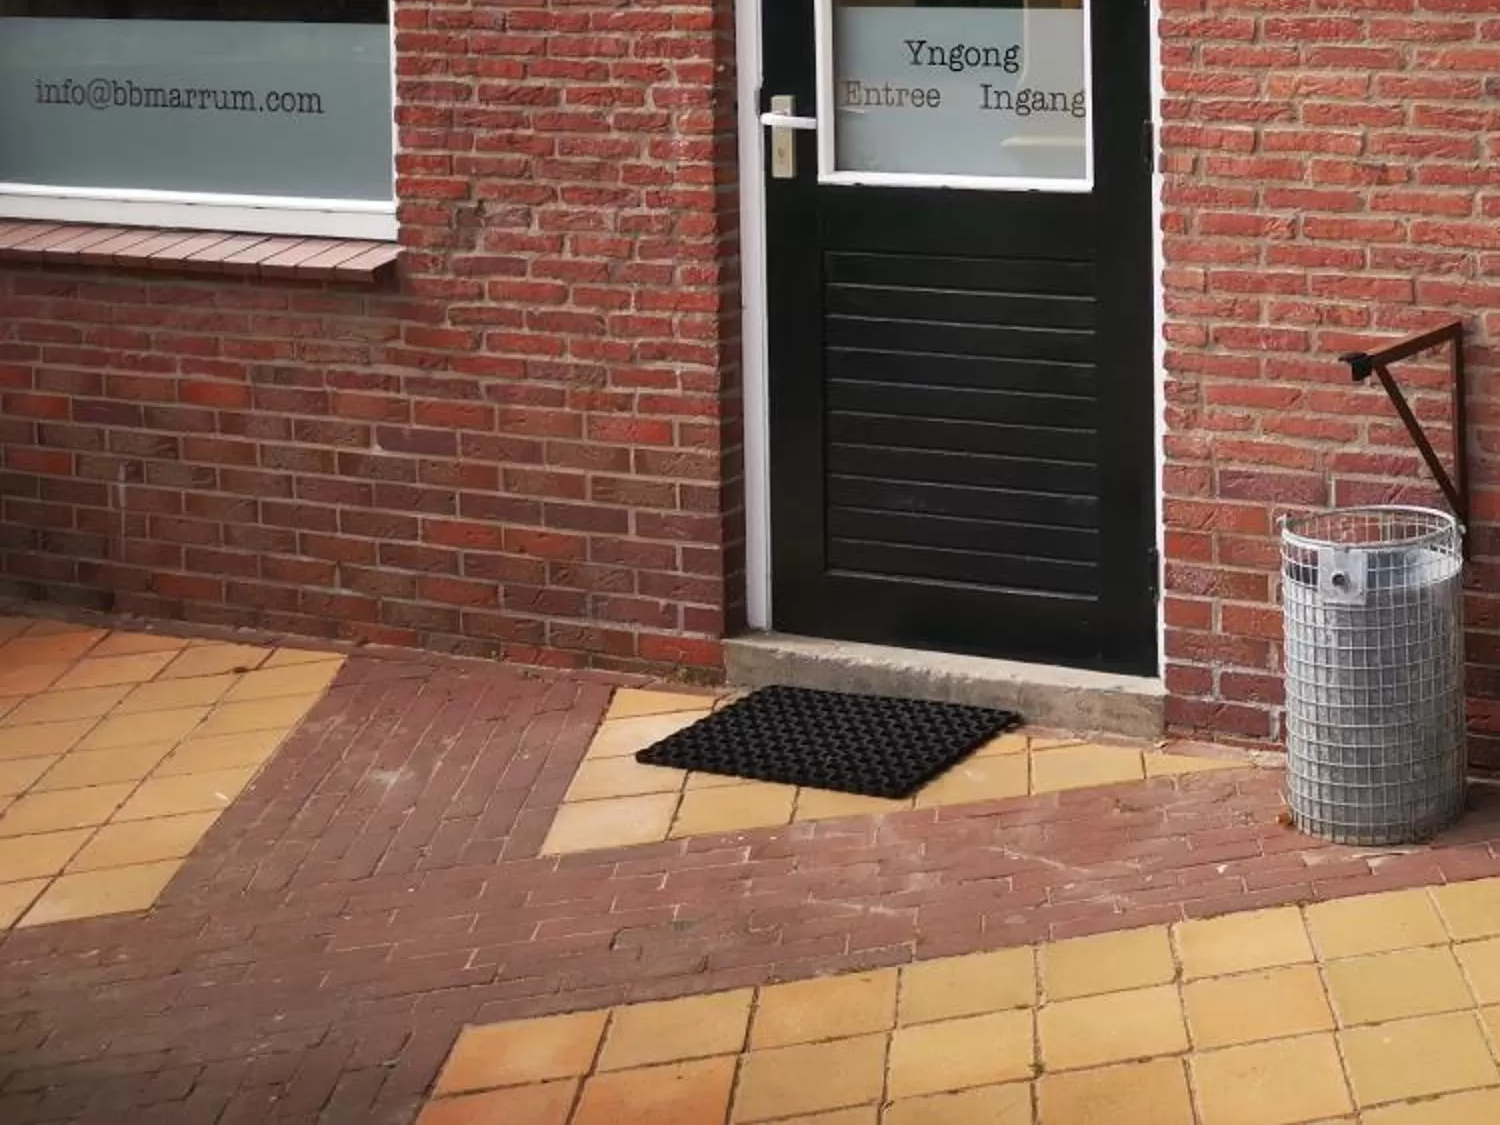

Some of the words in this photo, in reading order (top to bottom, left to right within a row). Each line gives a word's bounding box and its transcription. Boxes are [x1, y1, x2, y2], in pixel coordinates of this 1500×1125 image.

[904, 40, 1020, 73] Yngong
[35, 78, 325, 114] info@bbmarrum.com
[843, 80, 941, 107] Entree
[979, 84, 1086, 116] Ingang
